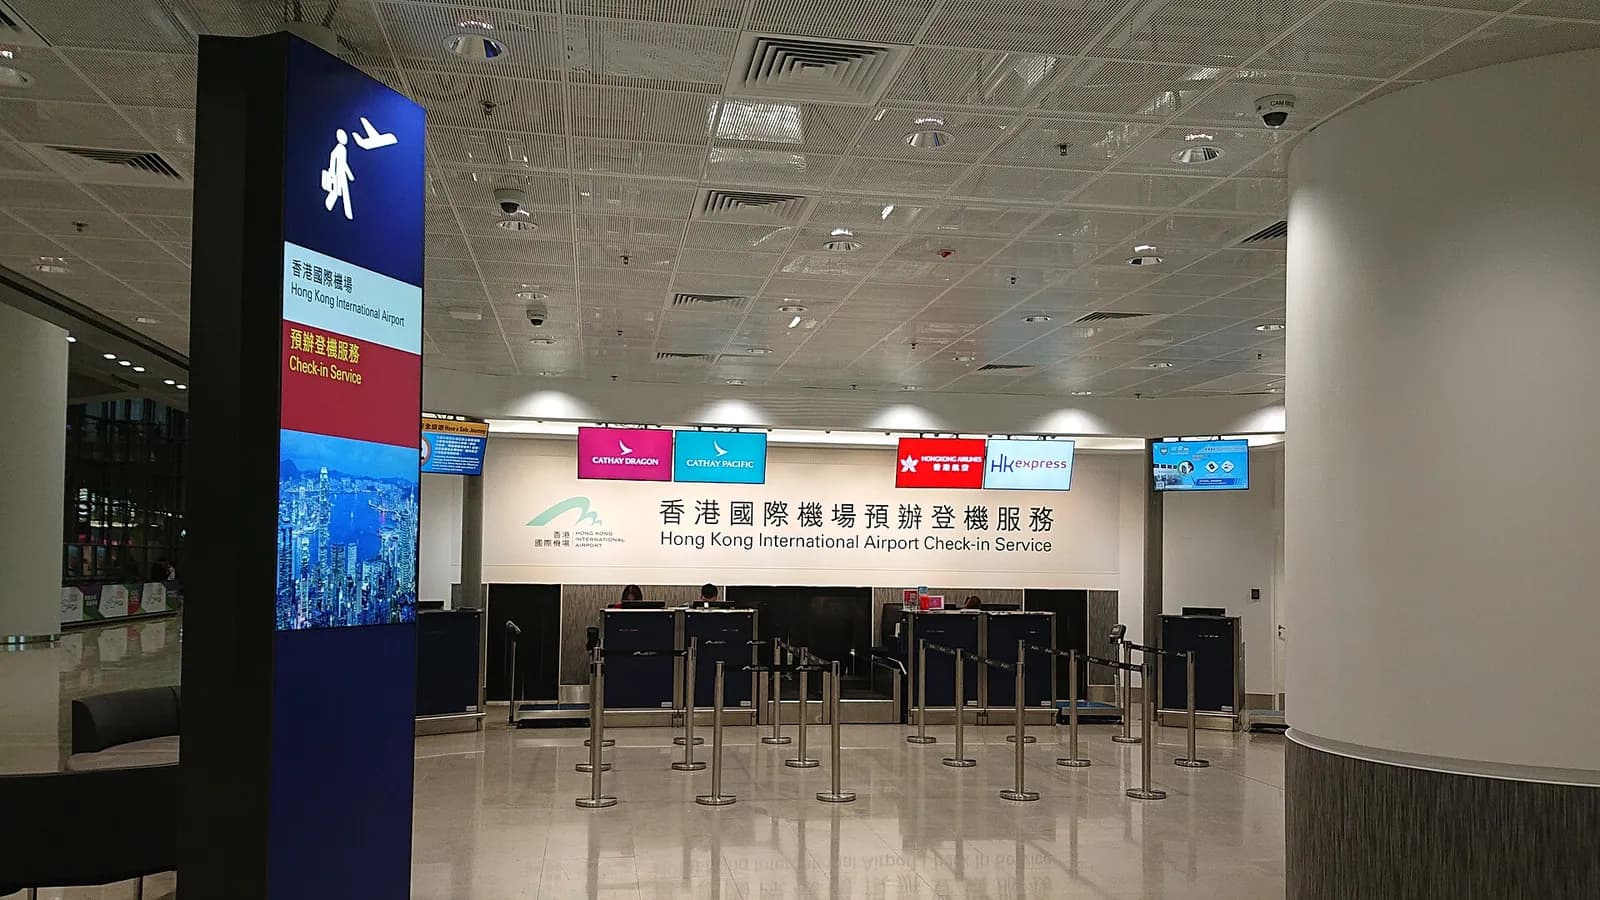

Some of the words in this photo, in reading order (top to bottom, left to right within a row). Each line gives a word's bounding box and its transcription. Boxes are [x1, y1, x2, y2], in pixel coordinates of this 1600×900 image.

[291, 259, 353, 294] 香港國際機場
[291, 282, 313, 303] Hong
[314, 289, 335, 309] Kong
[336, 296, 381, 319] International
[381, 310, 405, 327] Airport
[290, 328, 360, 364] 預辦登機服務
[289, 355, 329, 378] Check-in
[330, 364, 362, 385] Service
[592, 456, 624, 465] CATHAY
[625, 458, 659, 466] DRAGON
[686, 459, 720, 468] CATHAY
[722, 460, 754, 469] PACIFIC
[659, 499, 1054, 532] 香港國際機場預辦登機服務
[660, 531, 705, 550] Hong
[710, 532, 753, 550] Kong
[759, 532, 859, 549] International
[864, 535, 919, 552] Airport
[923, 535, 990, 551] Check-in
[995, 537, 1052, 552] Service
